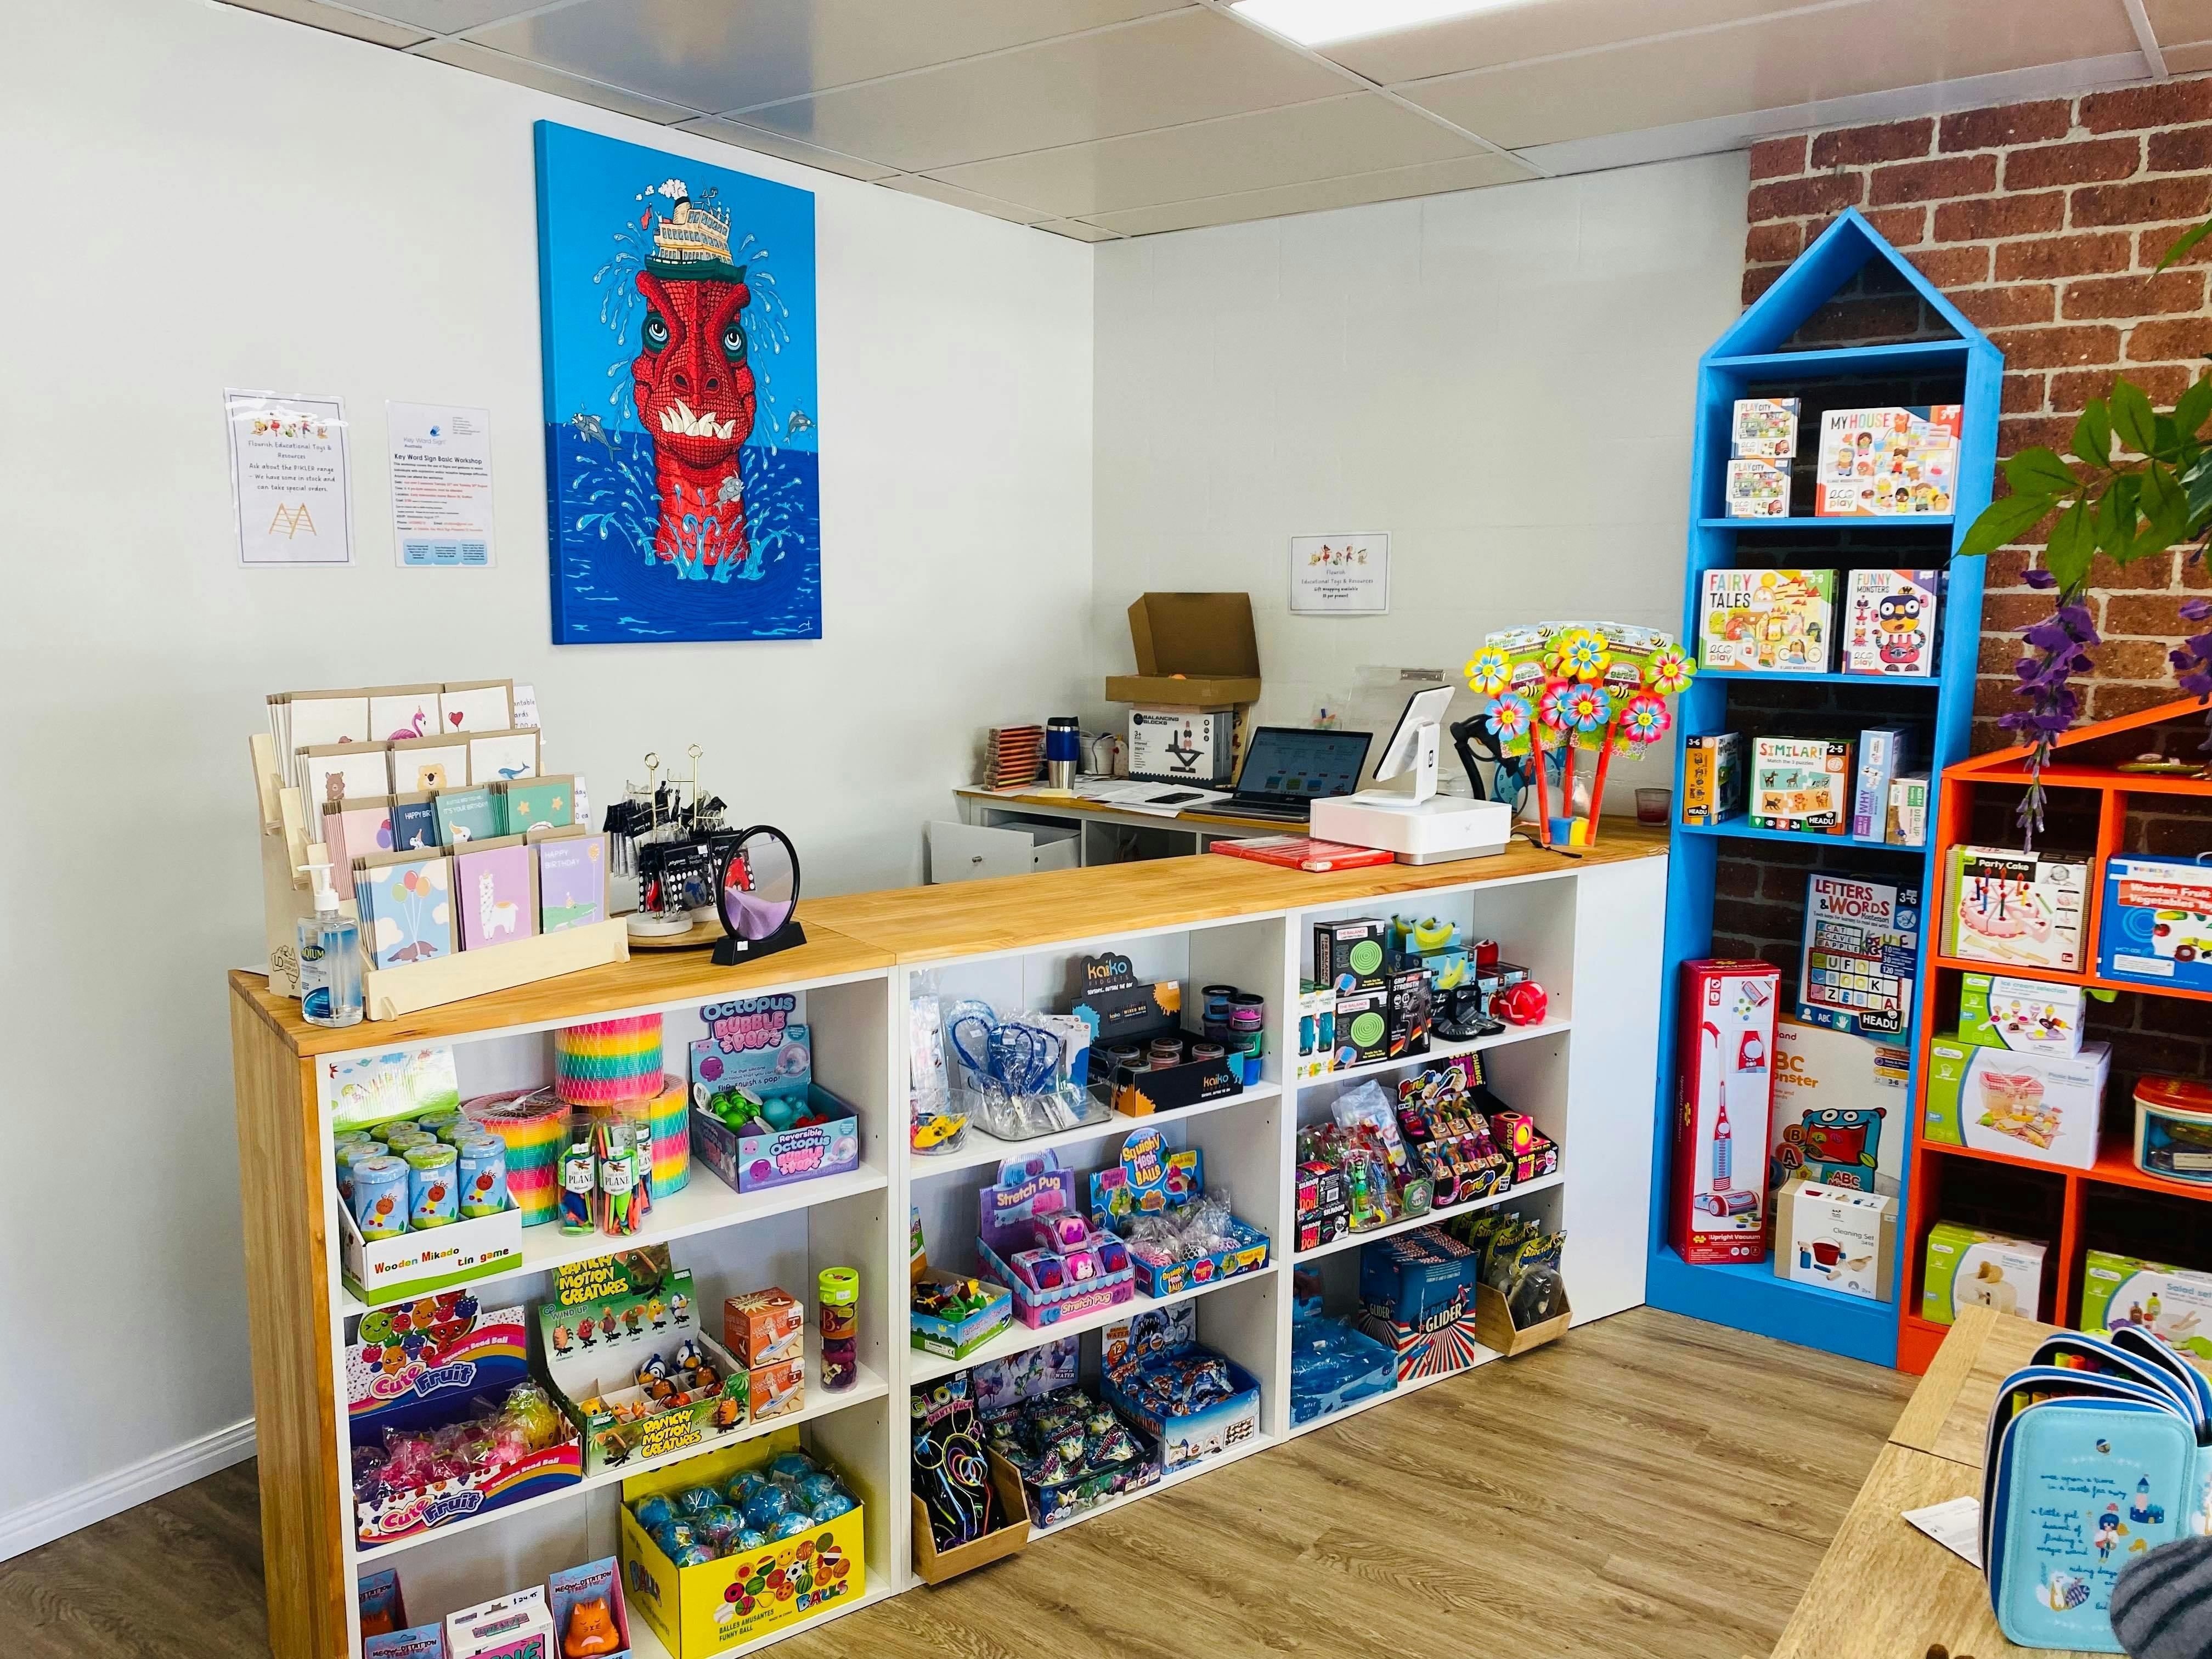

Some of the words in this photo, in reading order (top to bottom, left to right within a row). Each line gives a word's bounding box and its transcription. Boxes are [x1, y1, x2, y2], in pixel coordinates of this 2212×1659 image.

[1831, 415, 1848, 430] MY
[1849, 413, 1890, 429] HOUSE
[275, 441, 310, 449] Educational
[313, 444, 325, 452] Toys
[394, 454, 405, 462] Key
[1734, 463, 1752, 472] PLAY
[1829, 490, 1855, 499] eco
[1829, 499, 1854, 508] play
[1710, 573, 1752, 591] FAIRY
[1858, 573, 1891, 586] FUNNY
[1710, 593, 1751, 609] TALES
[1709, 644, 1734, 654] eco
[1709, 653, 1733, 663] play
[1515, 670, 1540, 680] garden
[1610, 670, 1637, 680] garden
[1759, 742, 1822, 760] SIMILAR!
[1829, 744, 1843, 754] 2-5
[1859, 789, 1870, 814] WHY
[404, 811, 422, 820] HAPPY
[1809, 816, 1835, 826] HEADU
[544, 849, 569, 859] HAPPY
[544, 857, 580, 869] BIRTHDAY
[1979, 858, 2004, 872] Party
[2006, 862, 2030, 871] Cake
[1815, 878, 1873, 901] LETTERS
[2130, 883, 2178, 895] Wooden
[2181, 888, 2211, 899] Fruit
[1829, 895, 1891, 917] WORDS
[2130, 894, 2195, 909] Vegetables
[1861, 913, 1890, 924] Montessori
[1087, 959, 1127, 980] kaiko
[1882, 966, 1893, 974] 120
[1088, 974, 1129, 986] FIDGETS
[1393, 981, 1420, 991] STRENGTH
[703, 997, 794, 1020] Octopus
[714, 1011, 785, 1039] BUBBLE
[1818, 1013, 1831, 1023] ABC
[1863, 1014, 1898, 1029] HEADU
[732, 1030, 770, 1051] POP
[1472, 1053, 1483, 1085] CHANGE
[764, 1076, 780, 1085] pop!
[1203, 1074, 1228, 1088] kaiko
[779, 1128, 823, 1143] Reversible
[770, 1136, 831, 1155] Octopus
[1122, 1132, 1160, 1161] Squishy
[1134, 1150, 1157, 1171] Mesh
[1518, 1154, 1536, 1164] COLOR
[568, 1173, 593, 1184] PLANE
[605, 1176, 629, 1186] PLANE
[1135, 1164, 1161, 1187] BALLS
[1833, 1170, 1861, 1187] ABC
[997, 1182, 1036, 1206] Stretch
[1039, 1176, 1061, 1190] Pug
[1461, 1171, 1494, 1200] Tangle
[1833, 1227, 1863, 1239] Cleaning
[1523, 1239, 1552, 1258] STRETCH
[374, 1257, 418, 1274] Wooden
[422, 1247, 460, 1263] Mikado
[458, 1256, 474, 1267] tin
[480, 1248, 509, 1263] game
[559, 1267, 614, 1290] MOTION
[1162, 1265, 1186, 1280] Squishy
[560, 1277, 629, 1306] CREATURES
[2166, 1283, 2195, 1295] Salad
[1061, 1297, 1093, 1314] Stretch
[1094, 1292, 1112, 1305] Pug
[551, 1309, 575, 1321] WIND
[577, 1306, 588, 1314] UP
[1370, 1304, 1390, 1319] GLIDER
[1425, 1302, 1463, 1333] GLIDER
[1106, 1330, 1130, 1340] WATER
[441, 1347, 469, 1364] Squeeze
[470, 1338, 490, 1351] Bead
[492, 1336, 509, 1345] Ball
[1113, 1345, 1122, 1354] 12
[374, 1365, 423, 1396] Cute
[416, 1363, 475, 1393] Fruit
[911, 1379, 968, 1418] GLOW
[694, 1414, 708, 1426] WIND
[927, 1405, 953, 1426] PARTY
[953, 1400, 974, 1413] PACK
[642, 1409, 694, 1434] PANICKY
[642, 1422, 691, 1446] MOTION
[642, 1430, 702, 1458] CREATURES
[491, 1470, 521, 1487] Squeeze
[522, 1460, 541, 1473] Bead
[543, 1457, 560, 1466] Ball
[381, 1500, 430, 1529] Cute
[424, 1492, 484, 1522] Fruit
[555, 1571, 612, 1593] MEOW-DITATION
[797, 1579, 849, 1612] BALLS
[719, 1622, 740, 1634] BALLES
[741, 1609, 775, 1626] AMUSANTES
[719, 1630, 737, 1642] FUNNY
[740, 1624, 753, 1634] BALL
[373, 1639, 437, 1657] MEOW-DITATION
